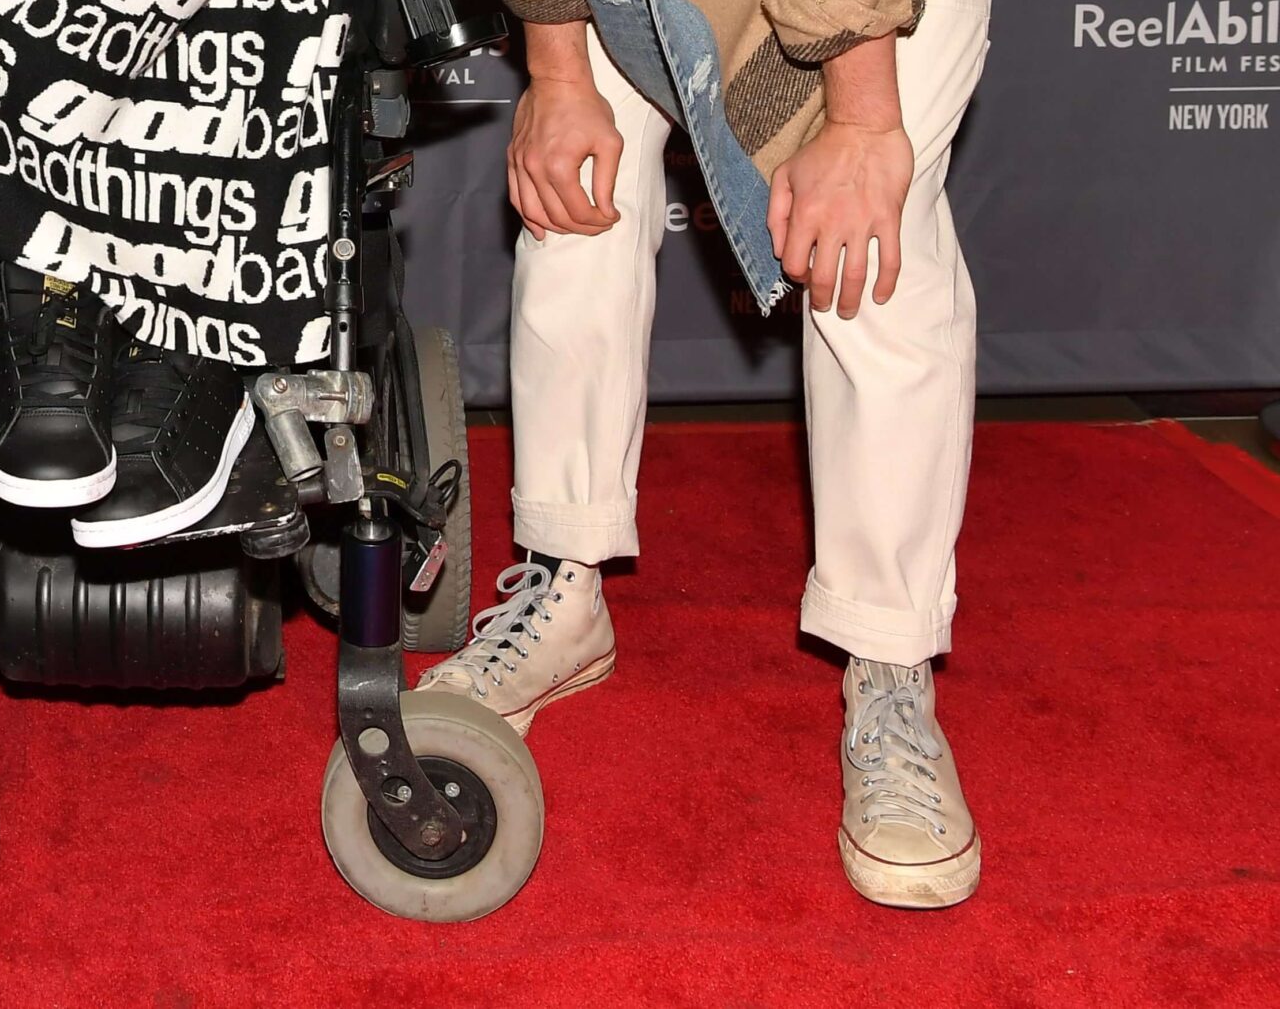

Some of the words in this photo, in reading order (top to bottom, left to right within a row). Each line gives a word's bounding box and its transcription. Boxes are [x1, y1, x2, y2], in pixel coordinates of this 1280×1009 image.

[1172, 56, 1227, 73] FILM
[1169, 104, 1213, 130] NEW
[1217, 103, 1269, 130] YORK
